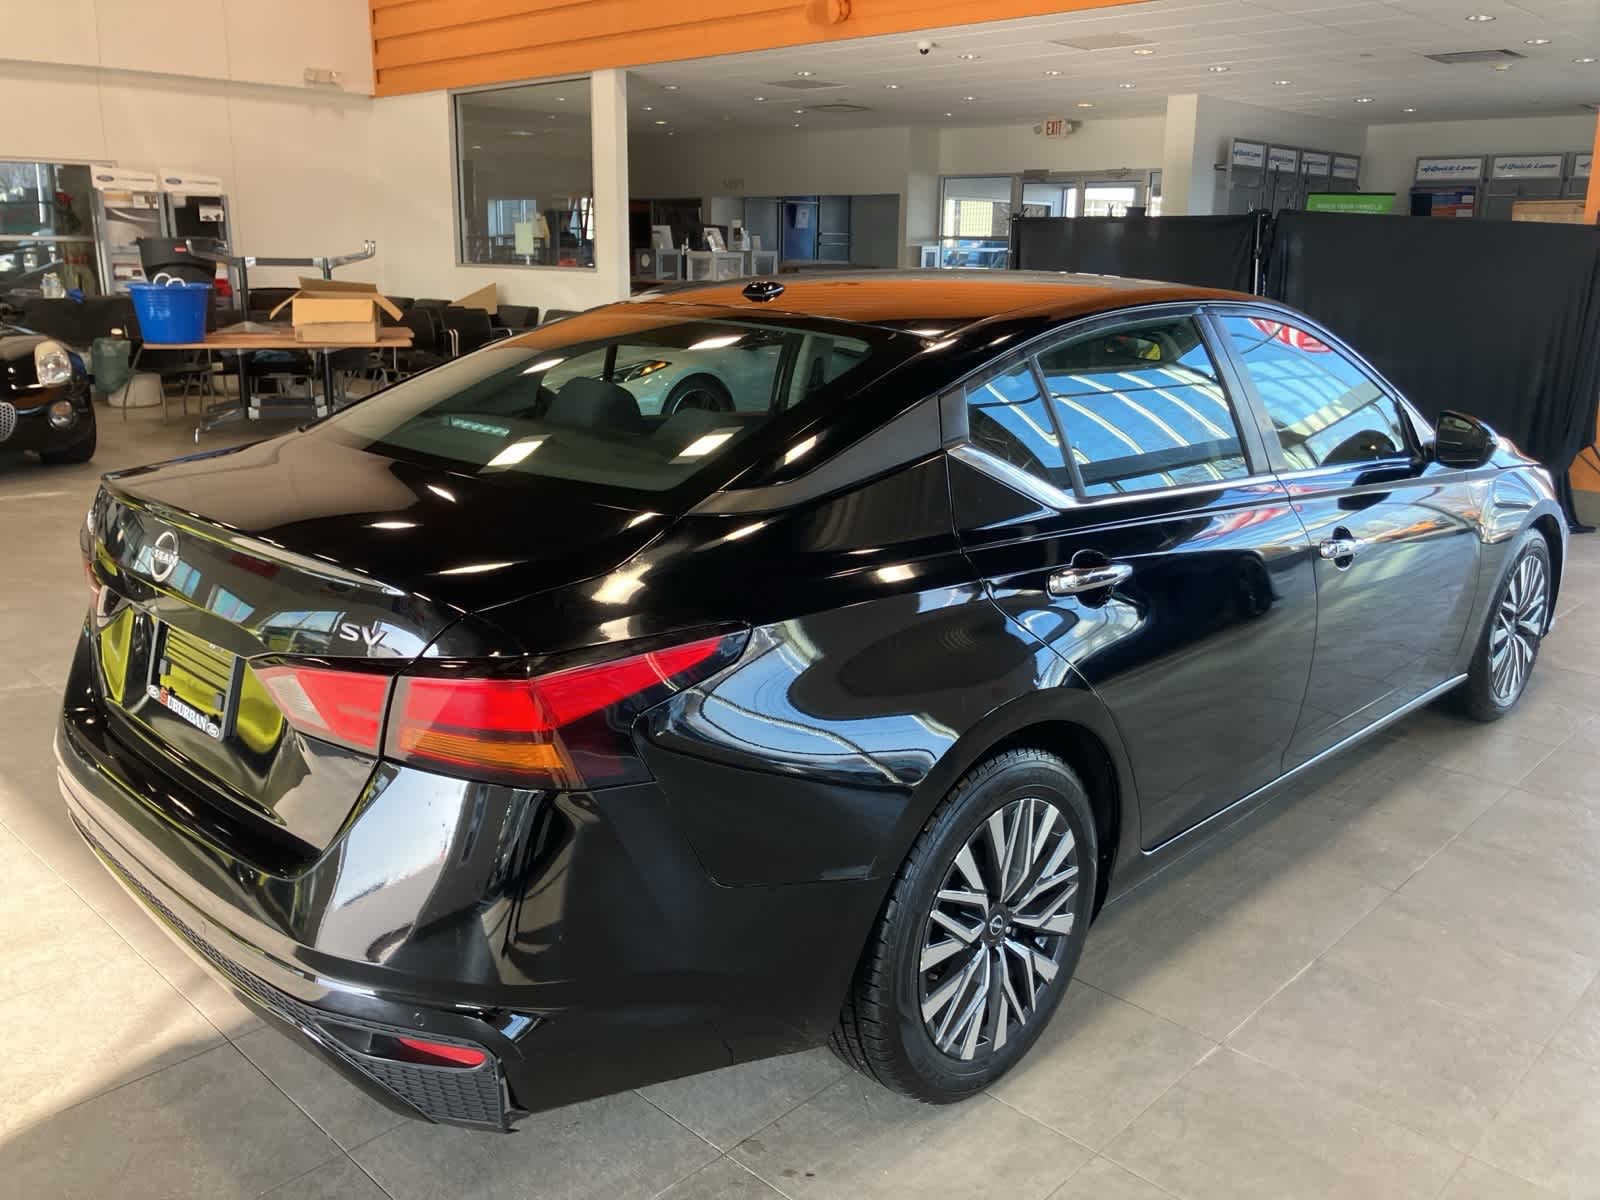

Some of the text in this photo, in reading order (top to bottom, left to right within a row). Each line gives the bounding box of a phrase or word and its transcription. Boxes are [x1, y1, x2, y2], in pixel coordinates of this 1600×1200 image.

[1046, 120, 1062, 136] EXIT
[1430, 164, 1455, 172] Quick
[1508, 162, 1532, 170] Quick
[338, 622, 388, 646] SV
[159, 686, 208, 731] SUBURBAN
